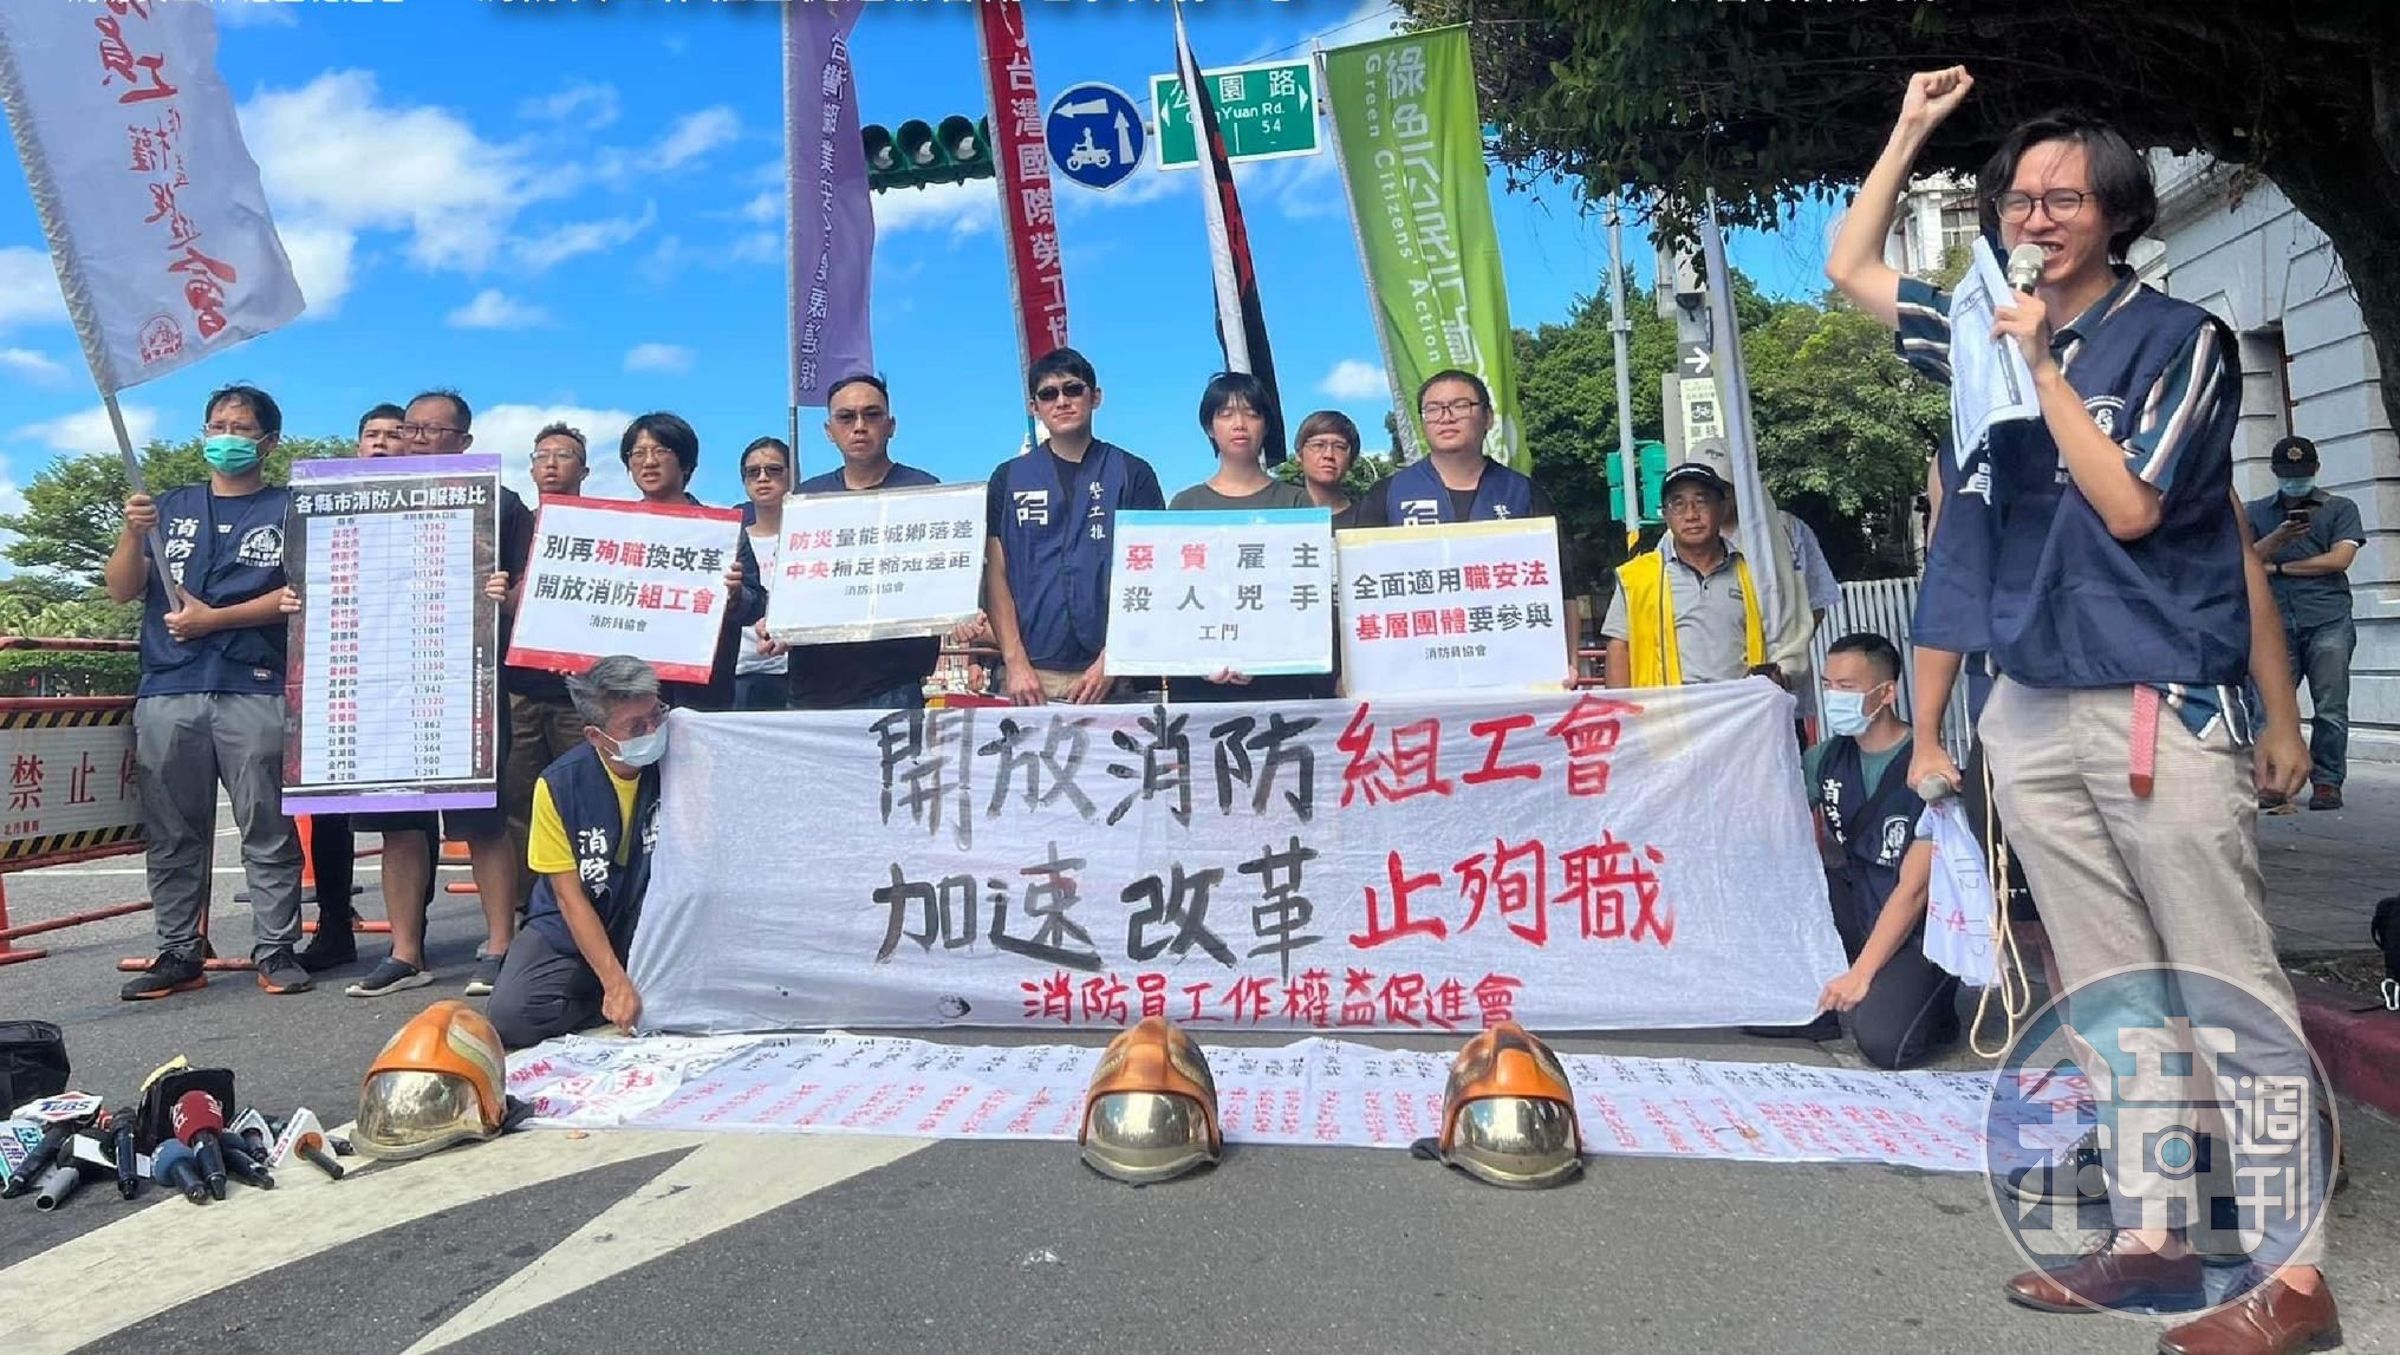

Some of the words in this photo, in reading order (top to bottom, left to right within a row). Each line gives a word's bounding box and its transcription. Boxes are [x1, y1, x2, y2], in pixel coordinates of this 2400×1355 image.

[1170, 69, 1295, 108] 公園路
[1261, 120, 1282, 133] 54
[1365, 54, 1382, 137] Green
[1408, 278, 1440, 362] Action
[295, 485, 487, 514] 各縣市消防人口服務比
[789, 519, 974, 551] 防災量能城鄉落差
[543, 535, 724, 575] 別再殉職換改革
[786, 551, 971, 579] 中央補足縮短差距
[1125, 542, 1320, 571] 惡質雇主
[534, 573, 716, 614] 開放消防組工會
[1122, 585, 1319, 612] 殺人兇手
[1354, 560, 1549, 600] 全面適用職安法
[589, 613, 648, 632] 消防員協會
[1356, 602, 1552, 641] 基層團體要參與
[1425, 644, 1487, 660] 消防員協會
[869, 693, 1644, 851] 開放消防組工會
[873, 829, 1674, 987] 加速改革止殉職
[1021, 966, 1526, 1030] 消防員工作權益促進會
